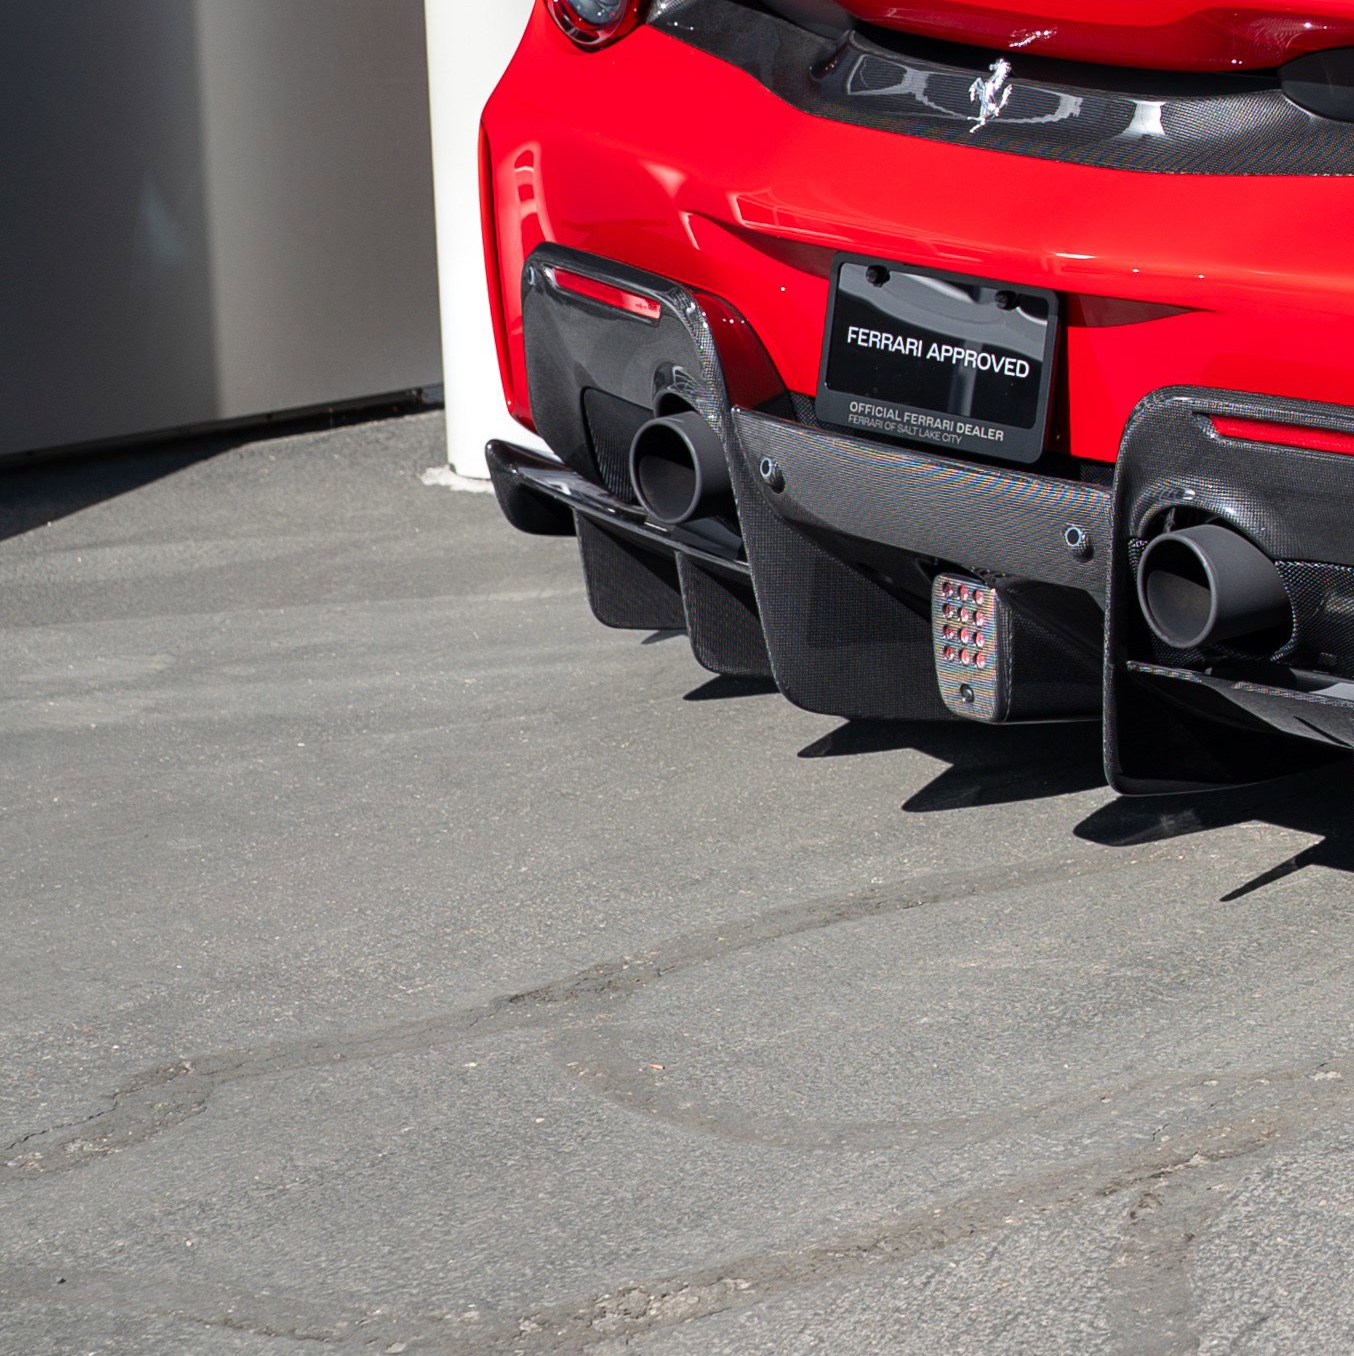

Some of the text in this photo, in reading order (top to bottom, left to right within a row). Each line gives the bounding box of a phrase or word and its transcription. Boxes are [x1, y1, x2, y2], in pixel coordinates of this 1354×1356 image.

[847, 326, 1030, 378] FERRARI APPROVED
[848, 414, 962, 444] FERRARI OF SALT LAKE CITY
[849, 401, 1004, 442] OFFICIAL FERRARI DEALER
